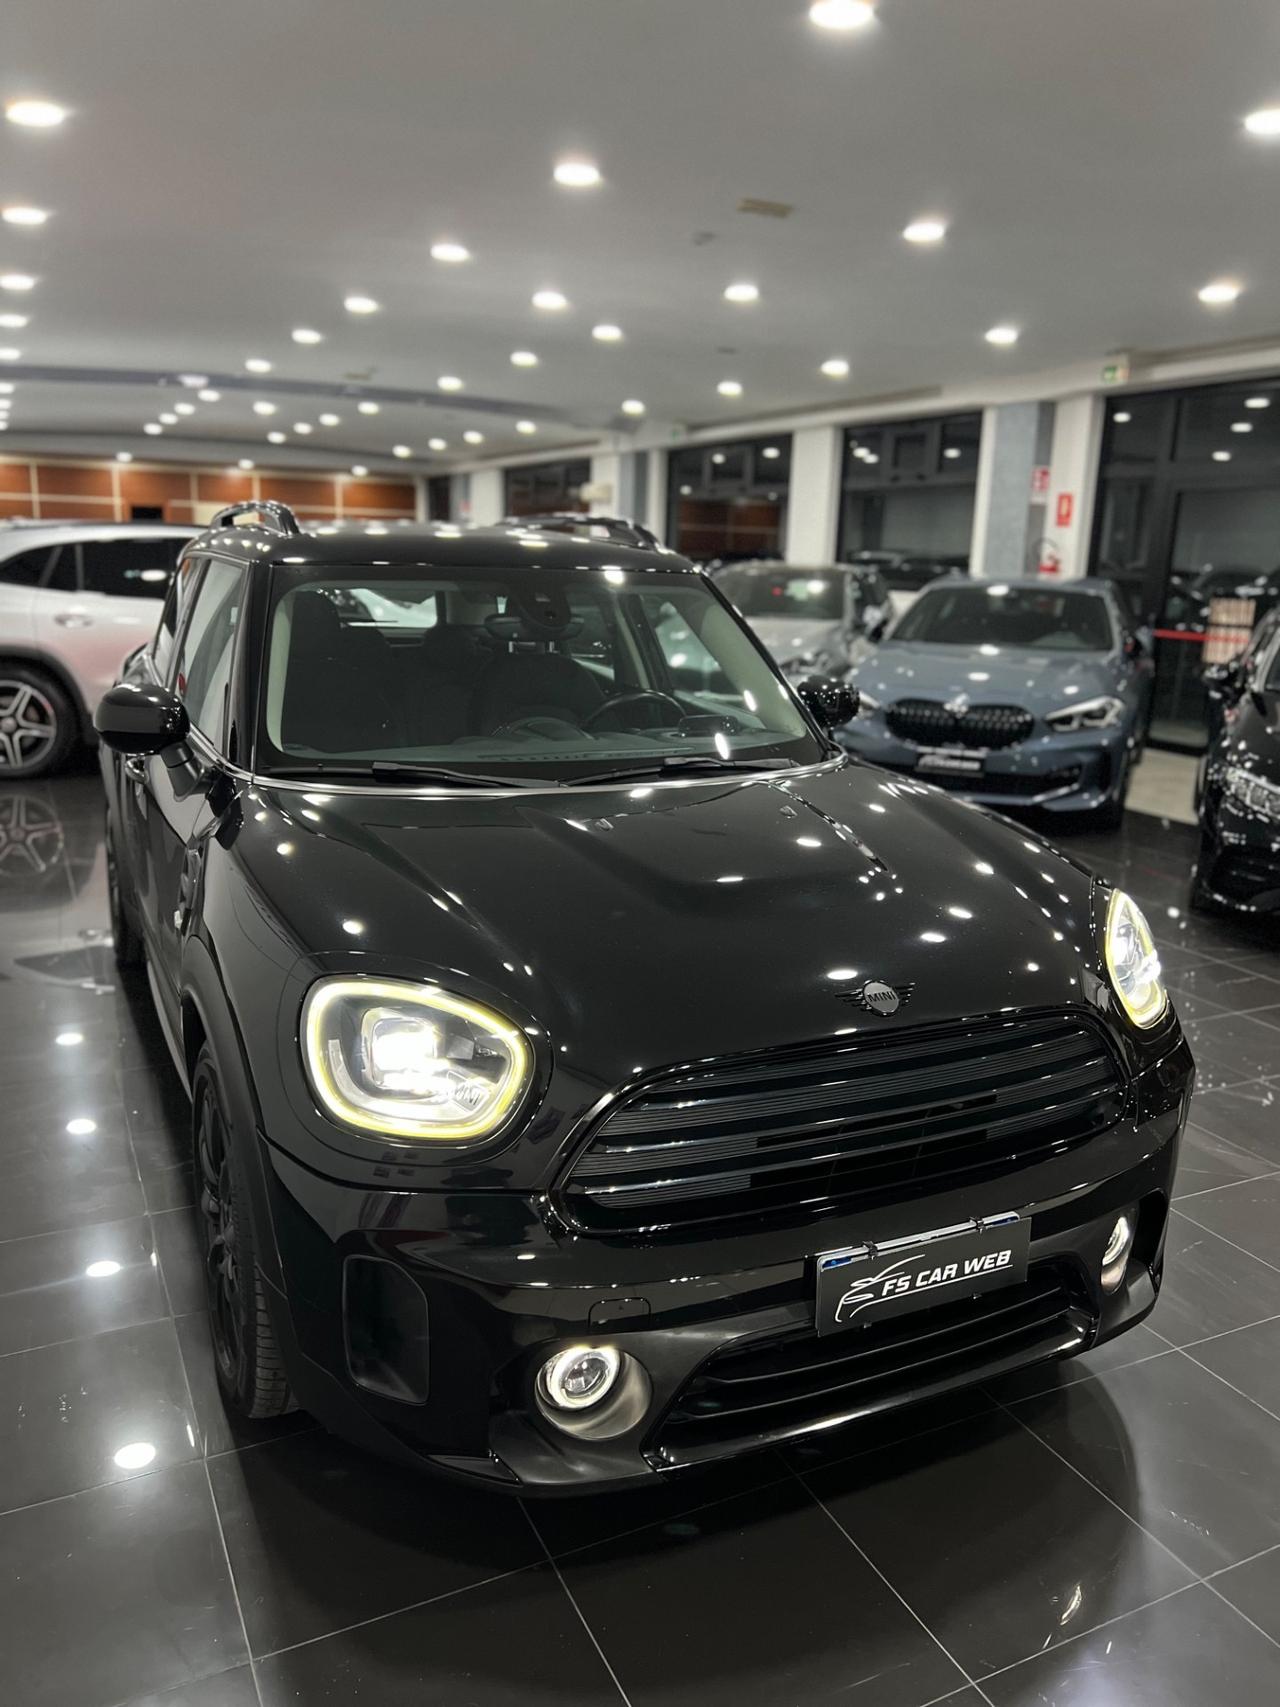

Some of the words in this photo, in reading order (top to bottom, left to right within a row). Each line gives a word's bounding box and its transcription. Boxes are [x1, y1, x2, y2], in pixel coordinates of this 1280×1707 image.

[867, 991, 896, 1002] MINI
[882, 1275, 912, 1296] FS
[915, 1264, 958, 1287] CAR
[963, 1250, 1012, 1273] WEB
